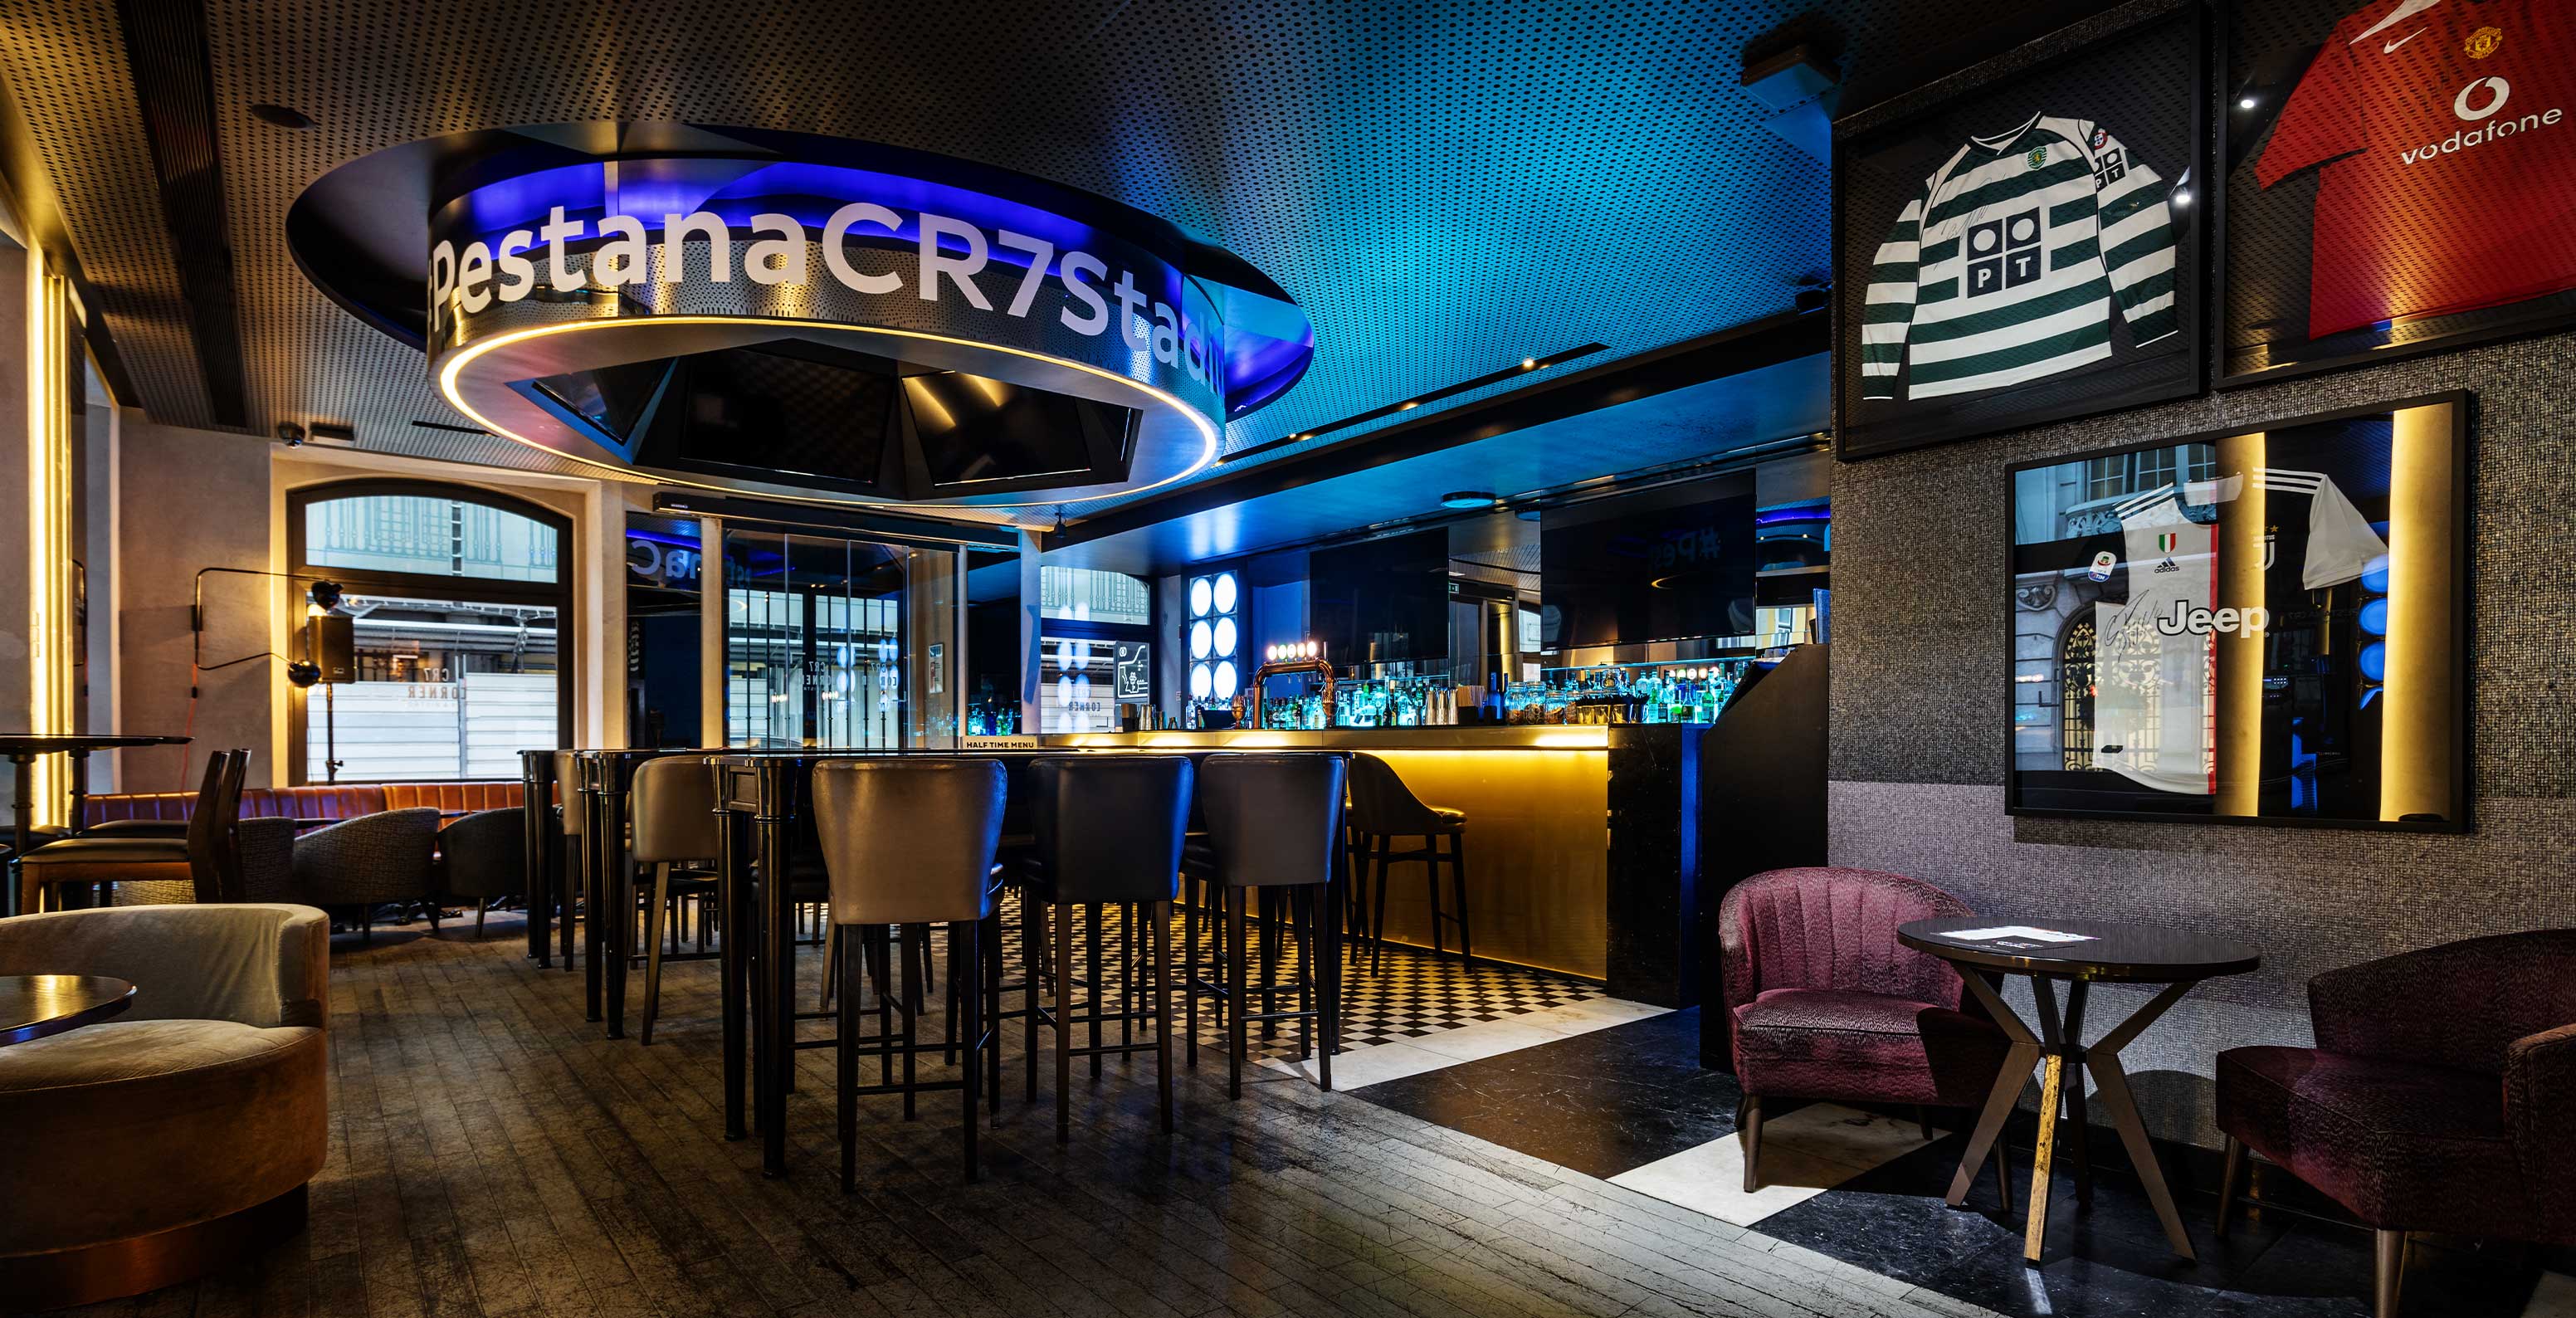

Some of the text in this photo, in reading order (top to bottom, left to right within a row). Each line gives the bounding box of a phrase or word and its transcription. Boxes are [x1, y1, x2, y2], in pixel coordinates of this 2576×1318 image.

[2400, 108, 2563, 165] vodafone
[2154, 564, 2180, 574] adidas
[2158, 599, 2270, 638] Jeep
